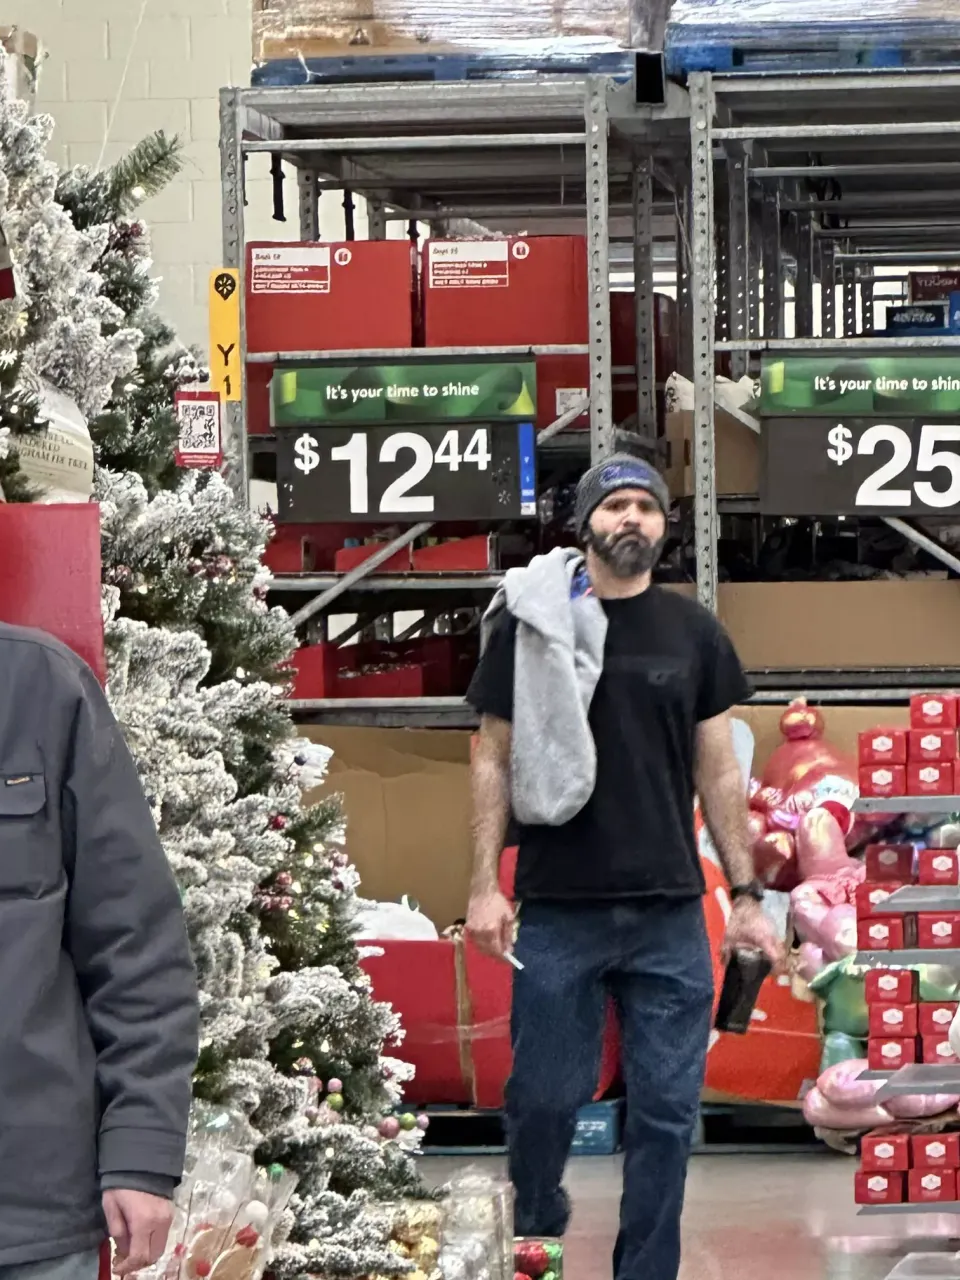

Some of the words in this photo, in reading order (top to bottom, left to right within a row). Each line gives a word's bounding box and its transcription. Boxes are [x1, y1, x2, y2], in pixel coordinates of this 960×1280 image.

[326, 385, 348, 400] It's
[351, 386, 383, 403] your
[387, 384, 419, 398] time
[423, 383, 438, 397] to
[442, 381, 480, 396] shine
[814, 376, 836, 391] It's
[840, 379, 872, 394] your
[875, 376, 908, 390] time
[912, 377, 928, 390] to
